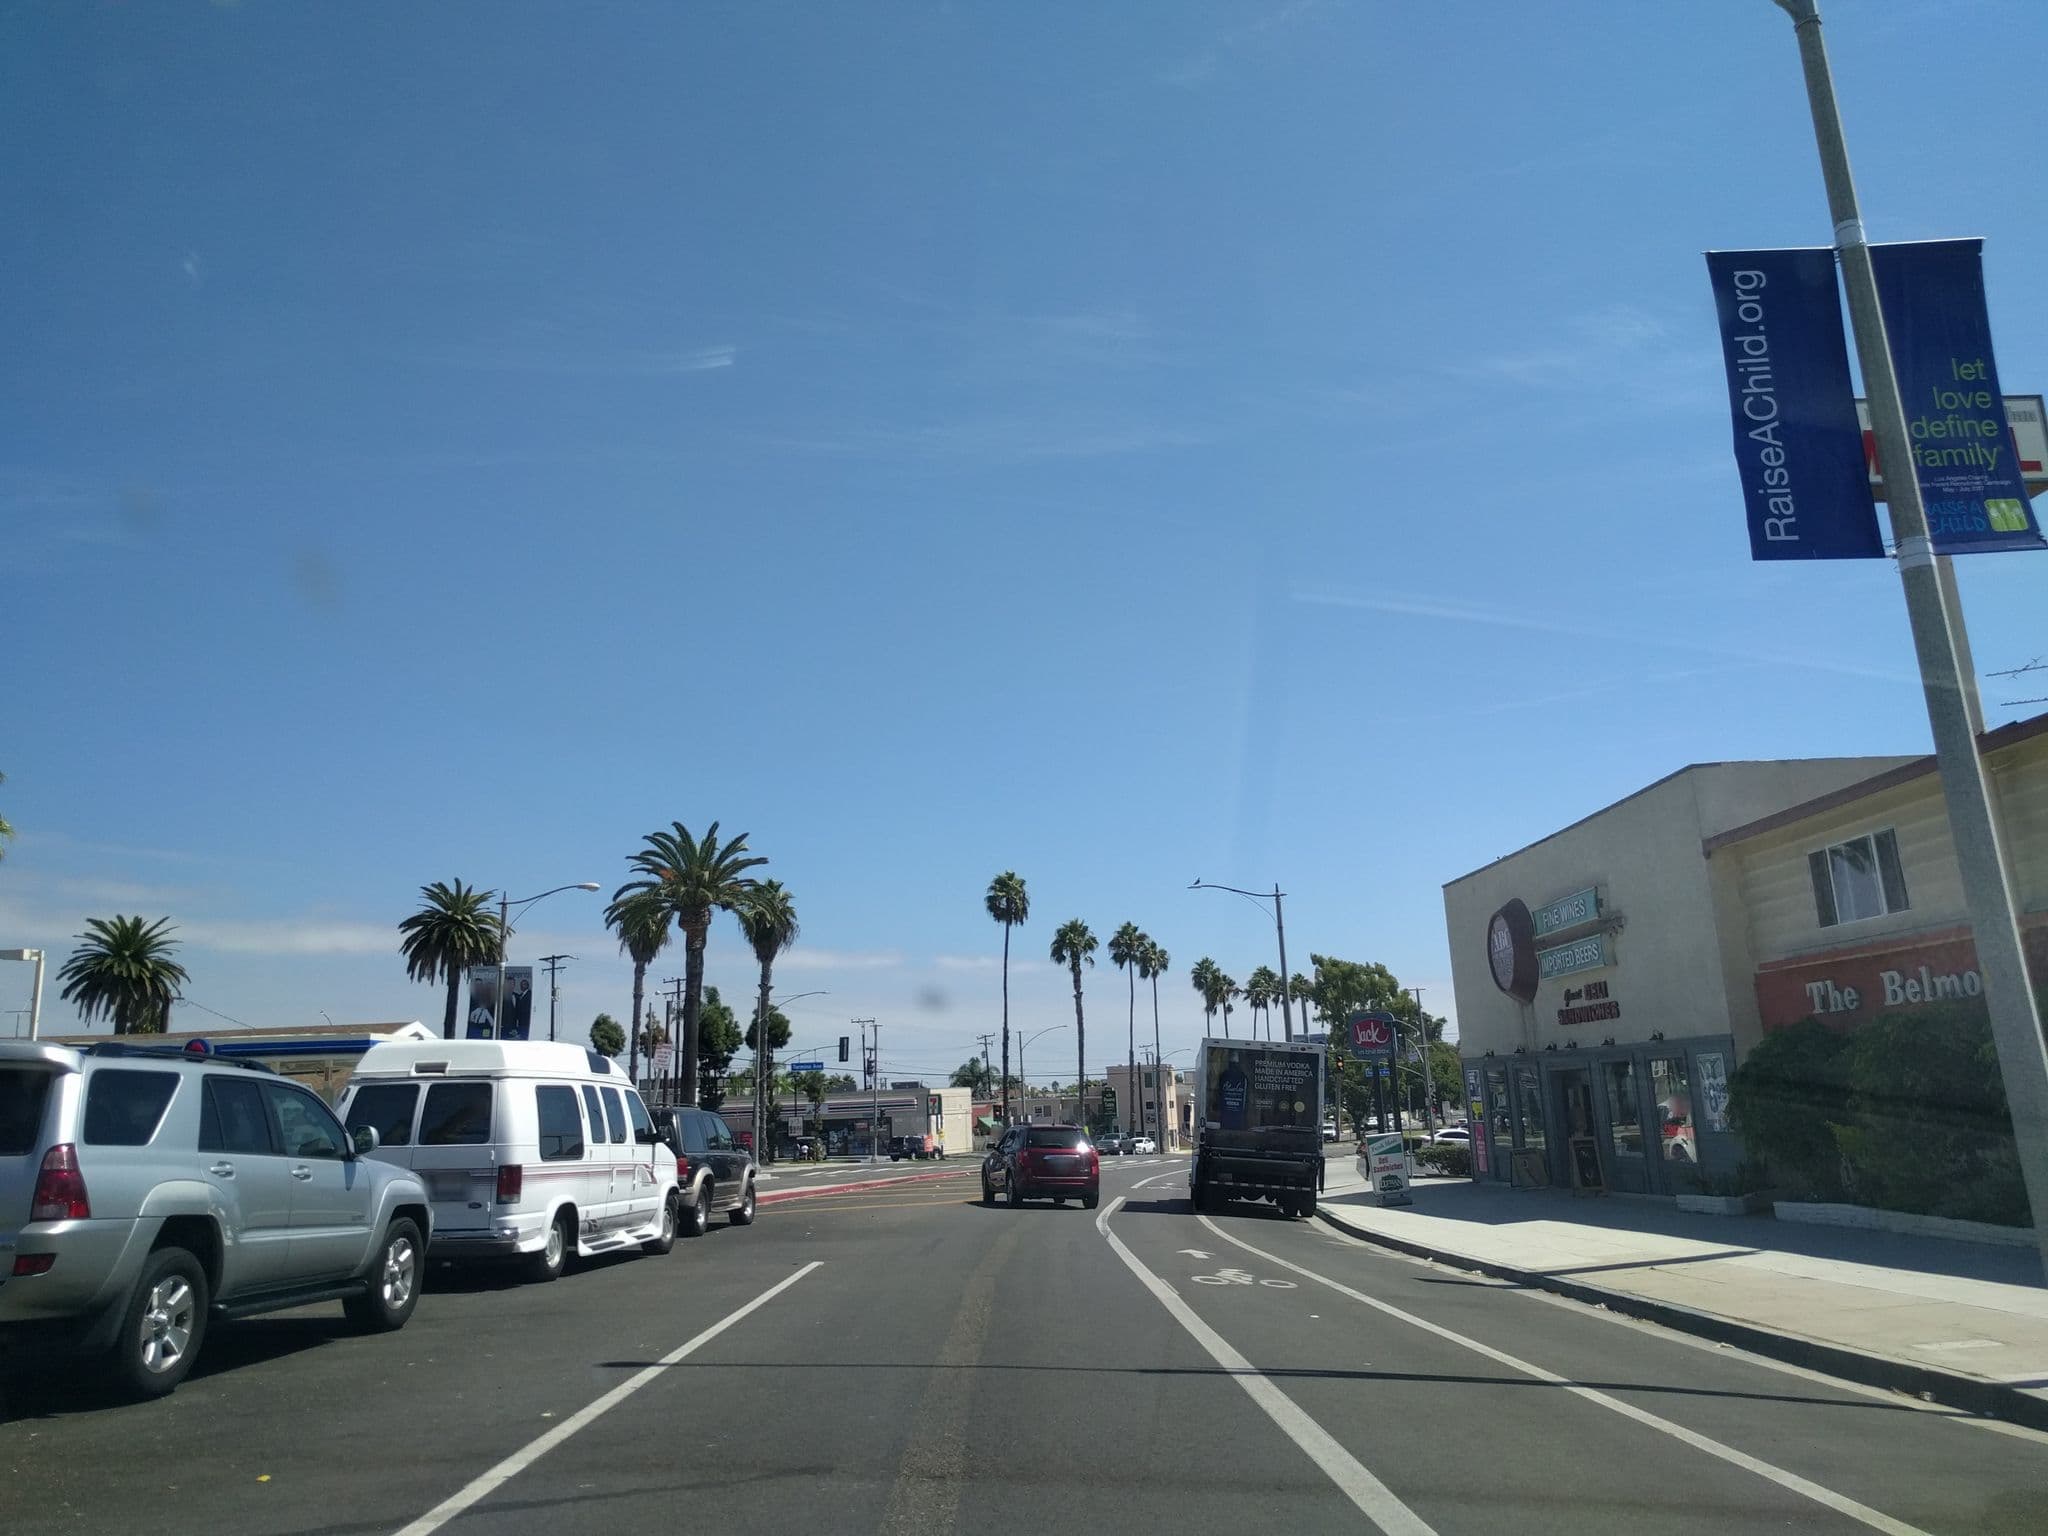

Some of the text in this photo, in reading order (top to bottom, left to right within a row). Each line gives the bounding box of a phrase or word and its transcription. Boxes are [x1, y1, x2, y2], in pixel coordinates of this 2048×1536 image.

[1952, 357, 1986, 381] let
[1733, 269, 1800, 542] RaiseAChild.org
[1932, 386, 1992, 409] love
[1911, 414, 1998, 440] define
[1913, 442, 2000, 471] family
[1542, 899, 1586, 929] FINE WINES
[1541, 950, 1575, 975] IMPORTED
[1575, 943, 1600, 968] BEERS
[1805, 979, 1860, 1015] The
[1355, 1021, 1390, 1045] Jack
[1254, 1059, 1287, 1068] PREMIUM
[1254, 1067, 1275, 1075] MADE
[1284, 1069, 1313, 1078] AMERICA
[1254, 1075, 1304, 1085] HANDCRAFTED
[1254, 1082, 1281, 1091] GLUTEN
[1281, 1084, 1297, 1092] FREE
